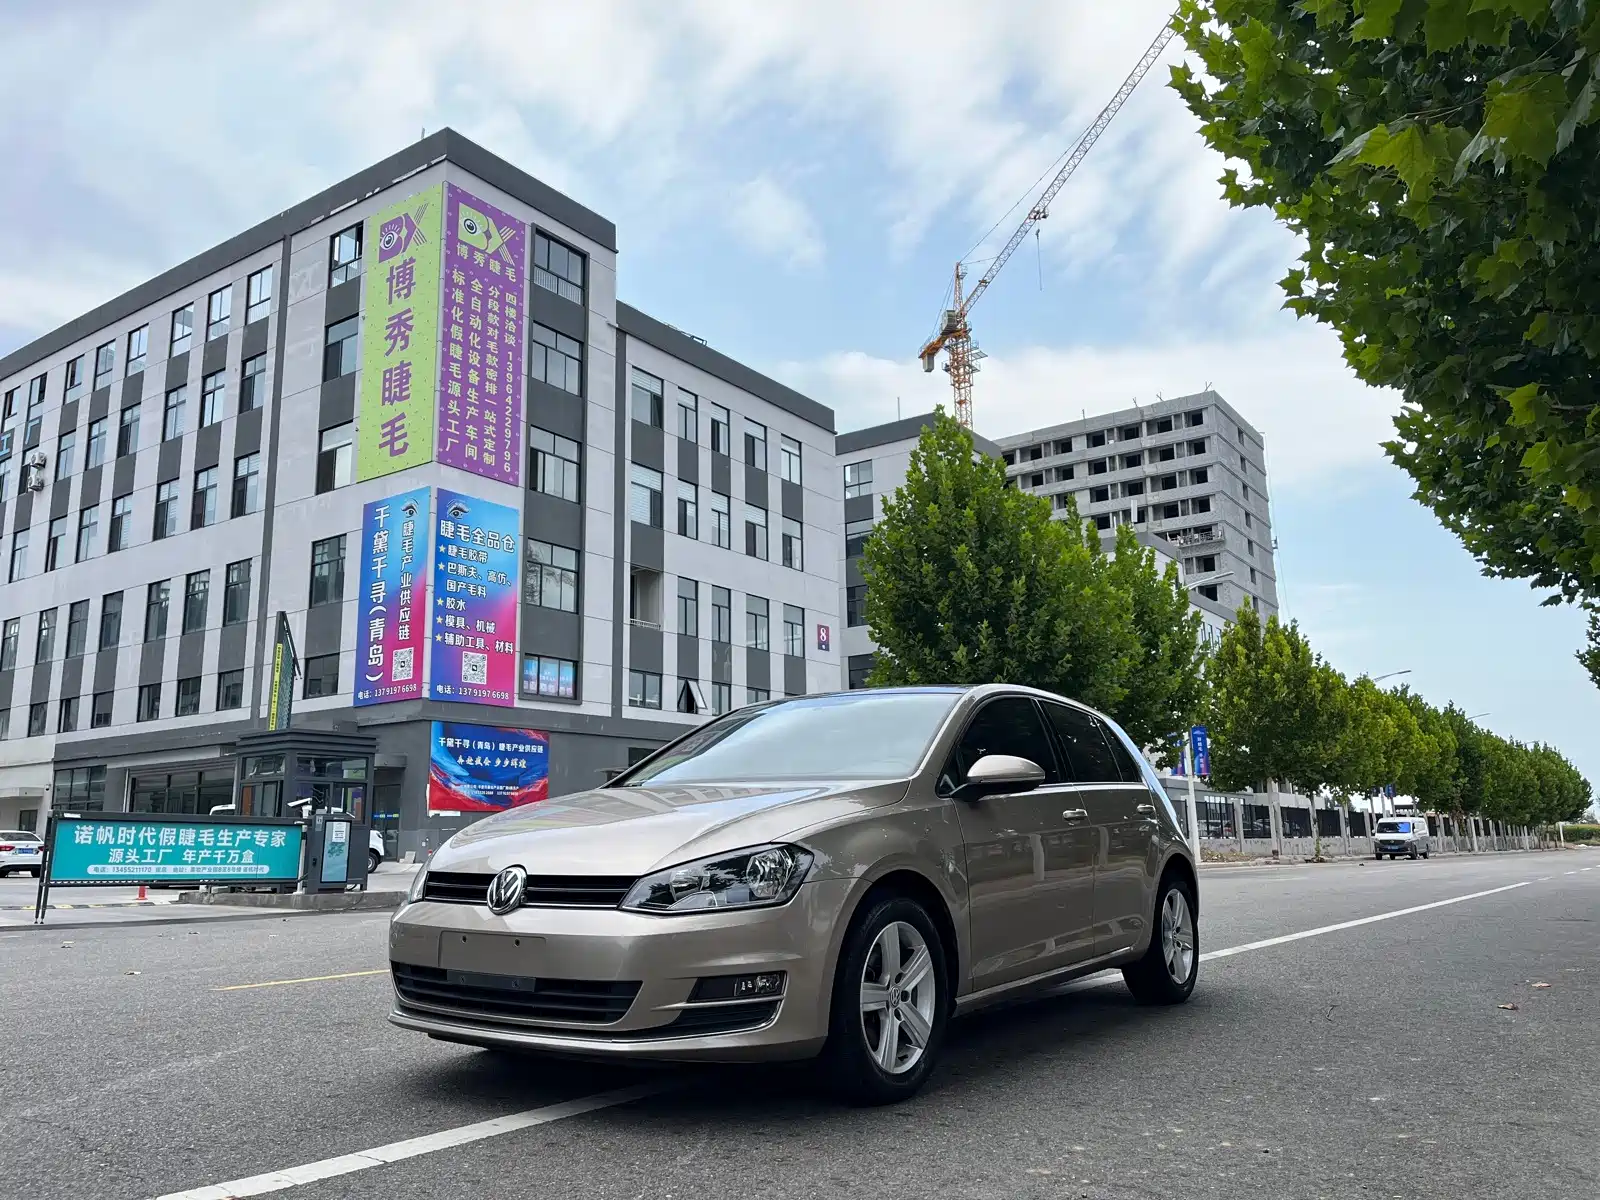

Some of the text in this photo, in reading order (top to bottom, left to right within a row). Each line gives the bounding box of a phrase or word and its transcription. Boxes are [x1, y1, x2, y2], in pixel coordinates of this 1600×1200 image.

[456, 242, 517, 283] 博秀睫毛
[378, 256, 416, 458] 博秀睫毛
[446, 269, 466, 452] 标准化假睫毛源头工厂
[465, 278, 483, 460] 全自动化设备生产车间
[440, 519, 515, 553] 睫毛全品仓
[447, 544, 489, 564] 睫毛胶带
[398, 520, 415, 641] 睫毛产业供应链
[446, 579, 487, 598] 国产毛料
[445, 597, 466, 611] 胶水
[73, 824, 287, 848] 诺帆时代假睫毛生产专家
[108, 848, 255, 865] 源头工厂 年产千万盒
